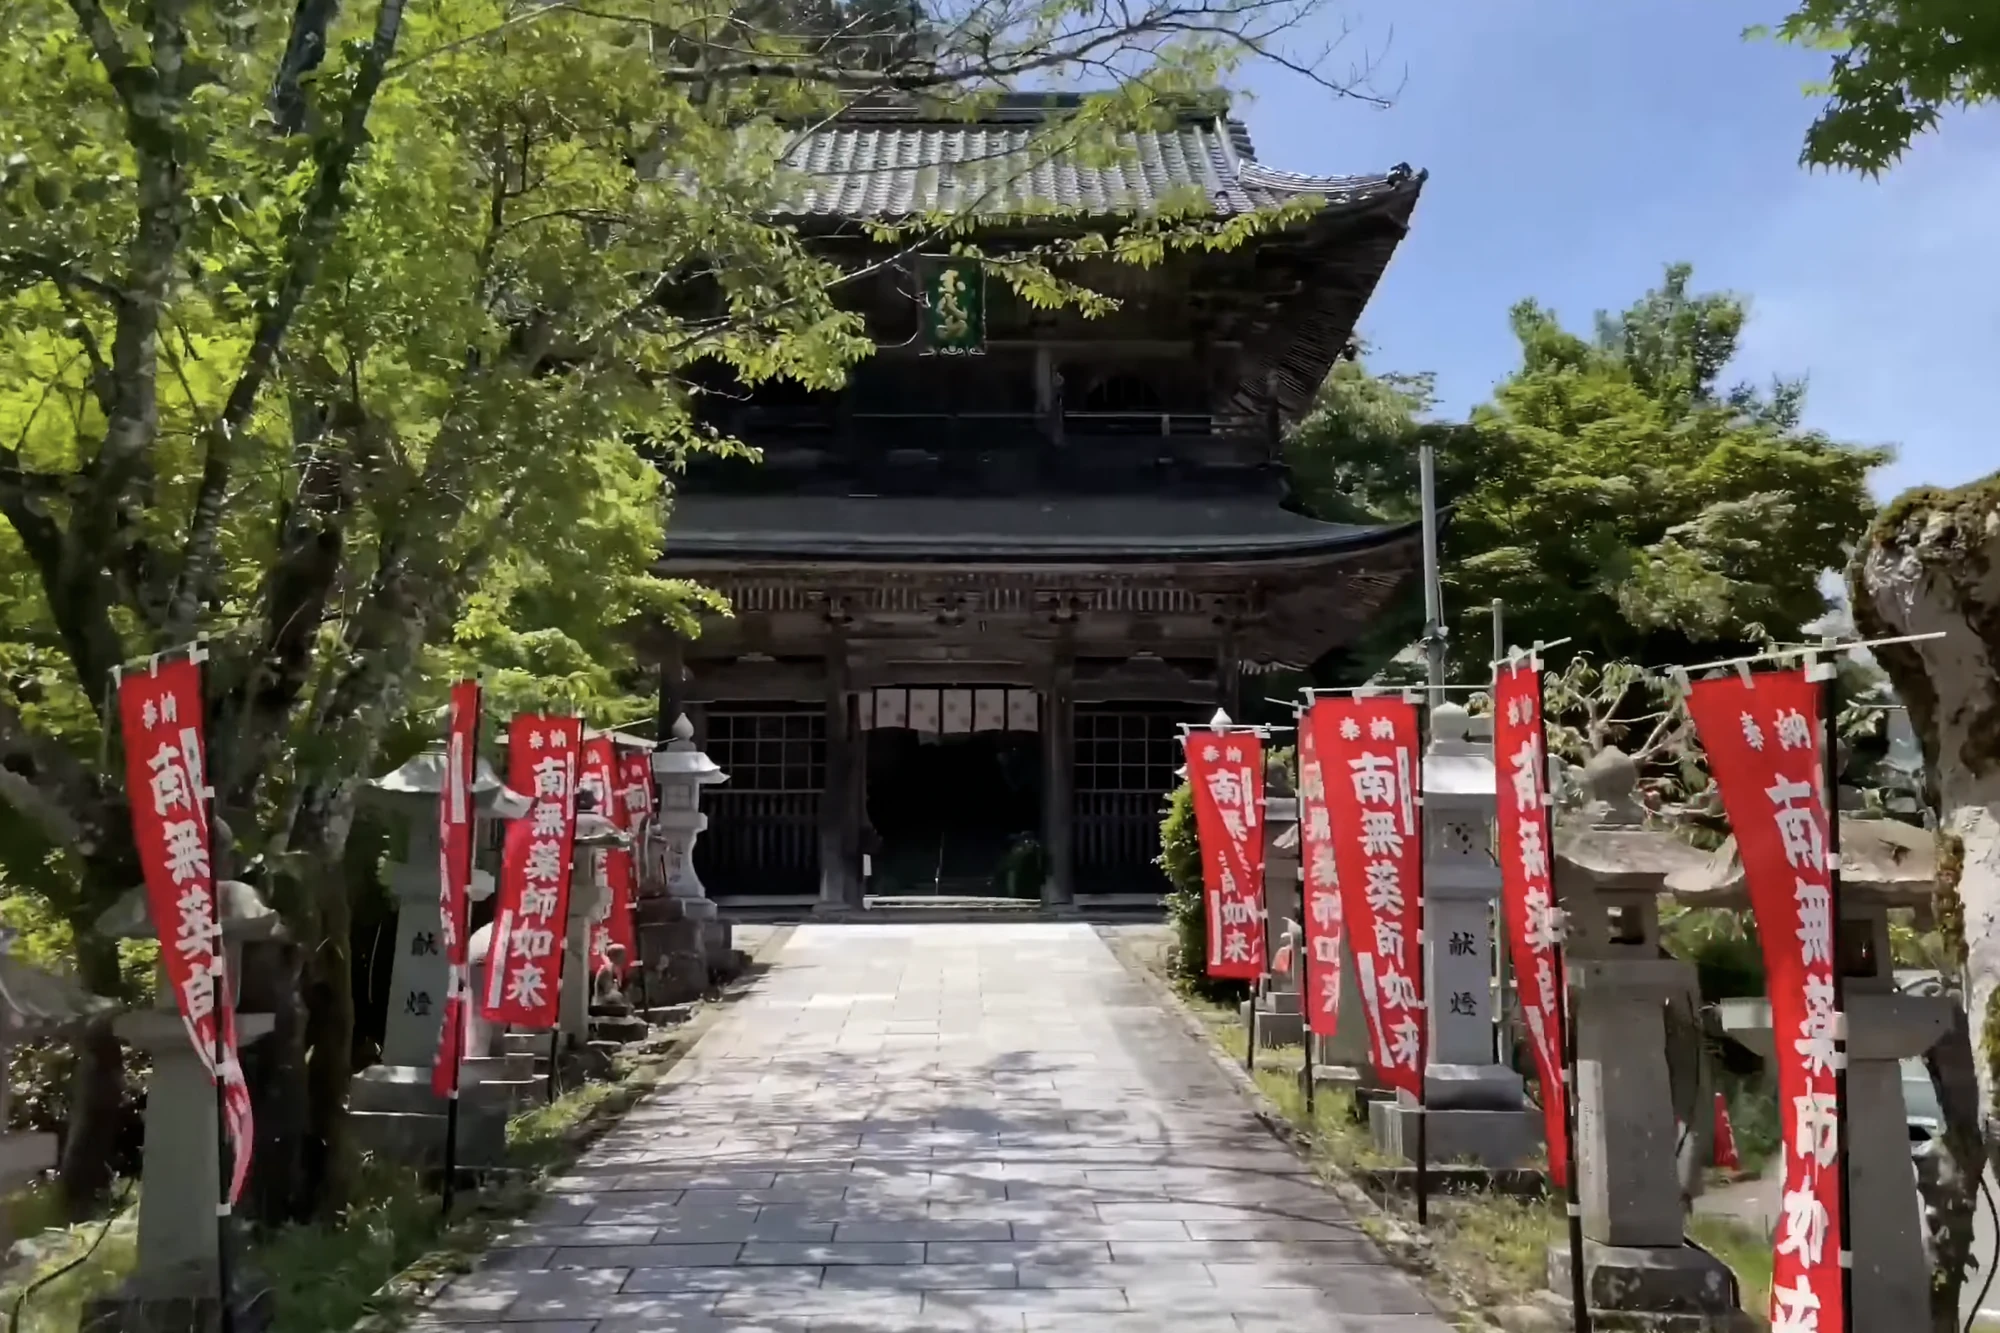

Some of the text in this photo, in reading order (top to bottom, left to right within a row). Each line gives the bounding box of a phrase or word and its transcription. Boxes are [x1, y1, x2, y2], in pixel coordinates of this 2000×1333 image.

[529, 728, 567, 749] 奉納
[1339, 716, 1395, 741] 奉納
[1739, 708, 1812, 752] 奉納
[1202, 745, 1242, 762] 奉納
[505, 756, 567, 1010] 南無薬師如来
[1347, 751, 1425, 1072] 南無薬師如来
